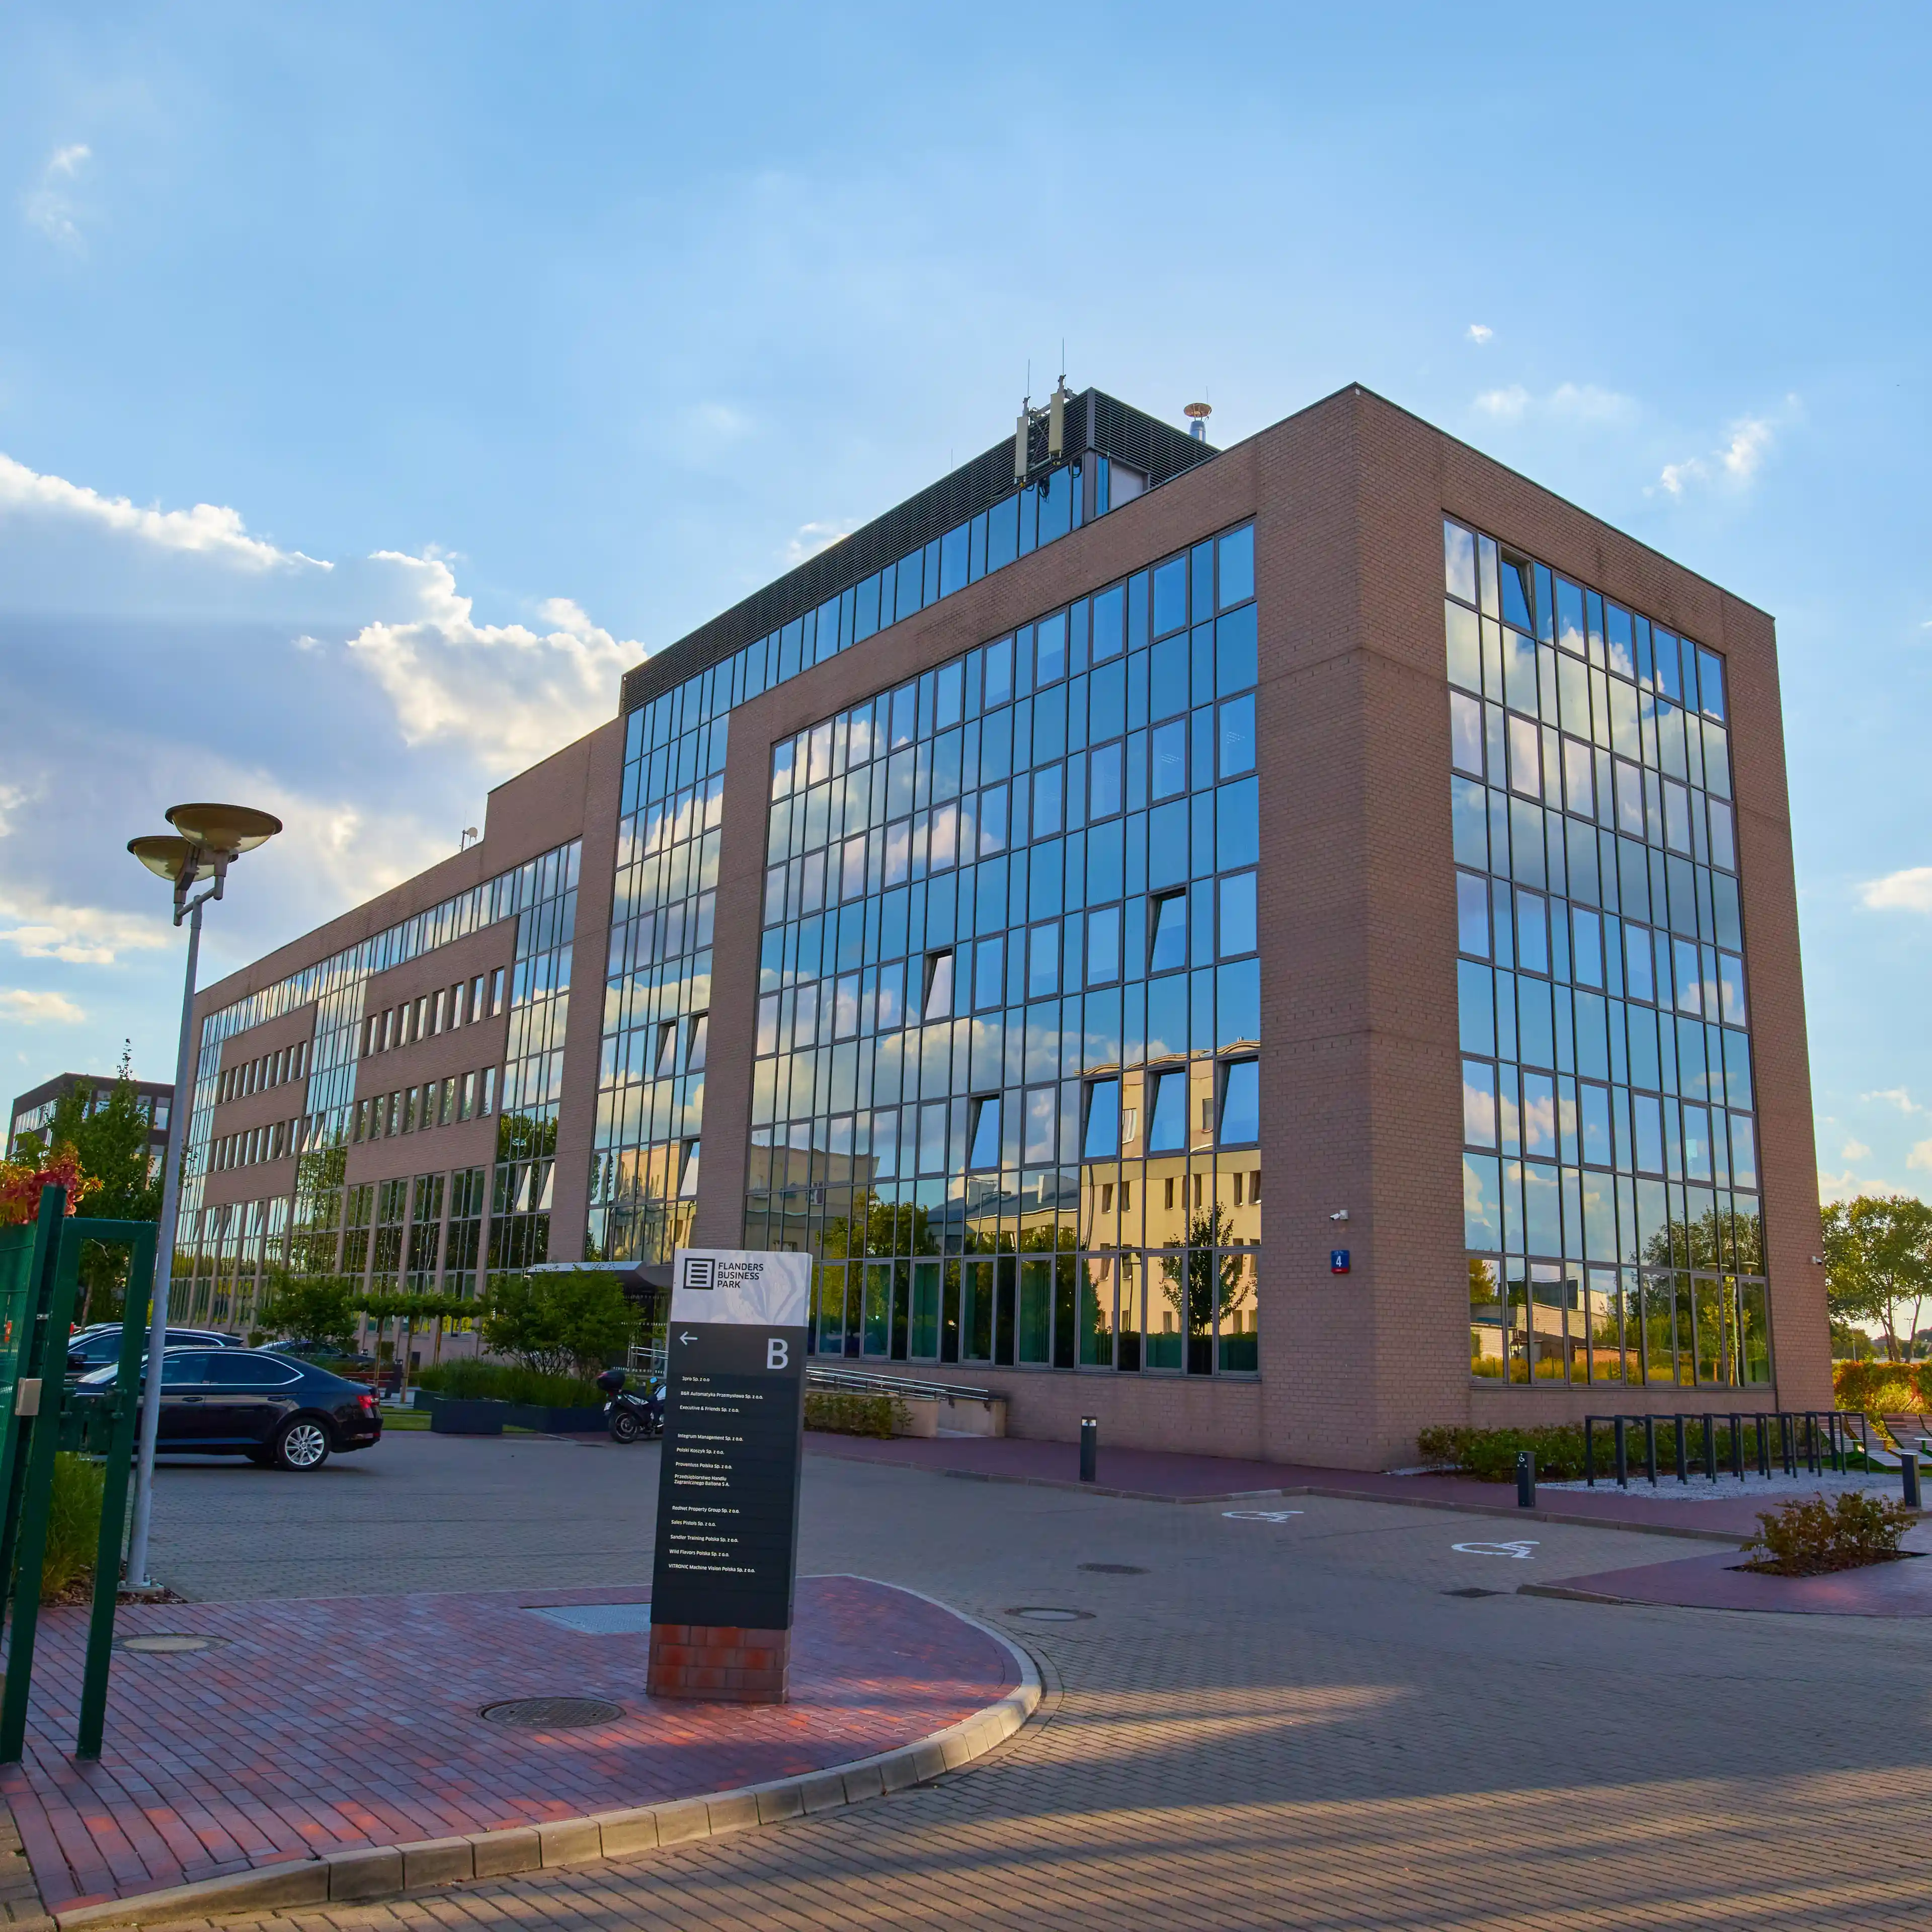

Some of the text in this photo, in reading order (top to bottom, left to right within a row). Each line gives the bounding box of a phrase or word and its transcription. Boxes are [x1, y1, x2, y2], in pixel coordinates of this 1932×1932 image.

[1336, 1255, 1342, 1267] 4
[718, 1262, 764, 1271] FLANDERS
[717, 1272, 759, 1280] BUSINESS
[717, 1280, 741, 1289] PARK
[767, 1338, 788, 1369] B
